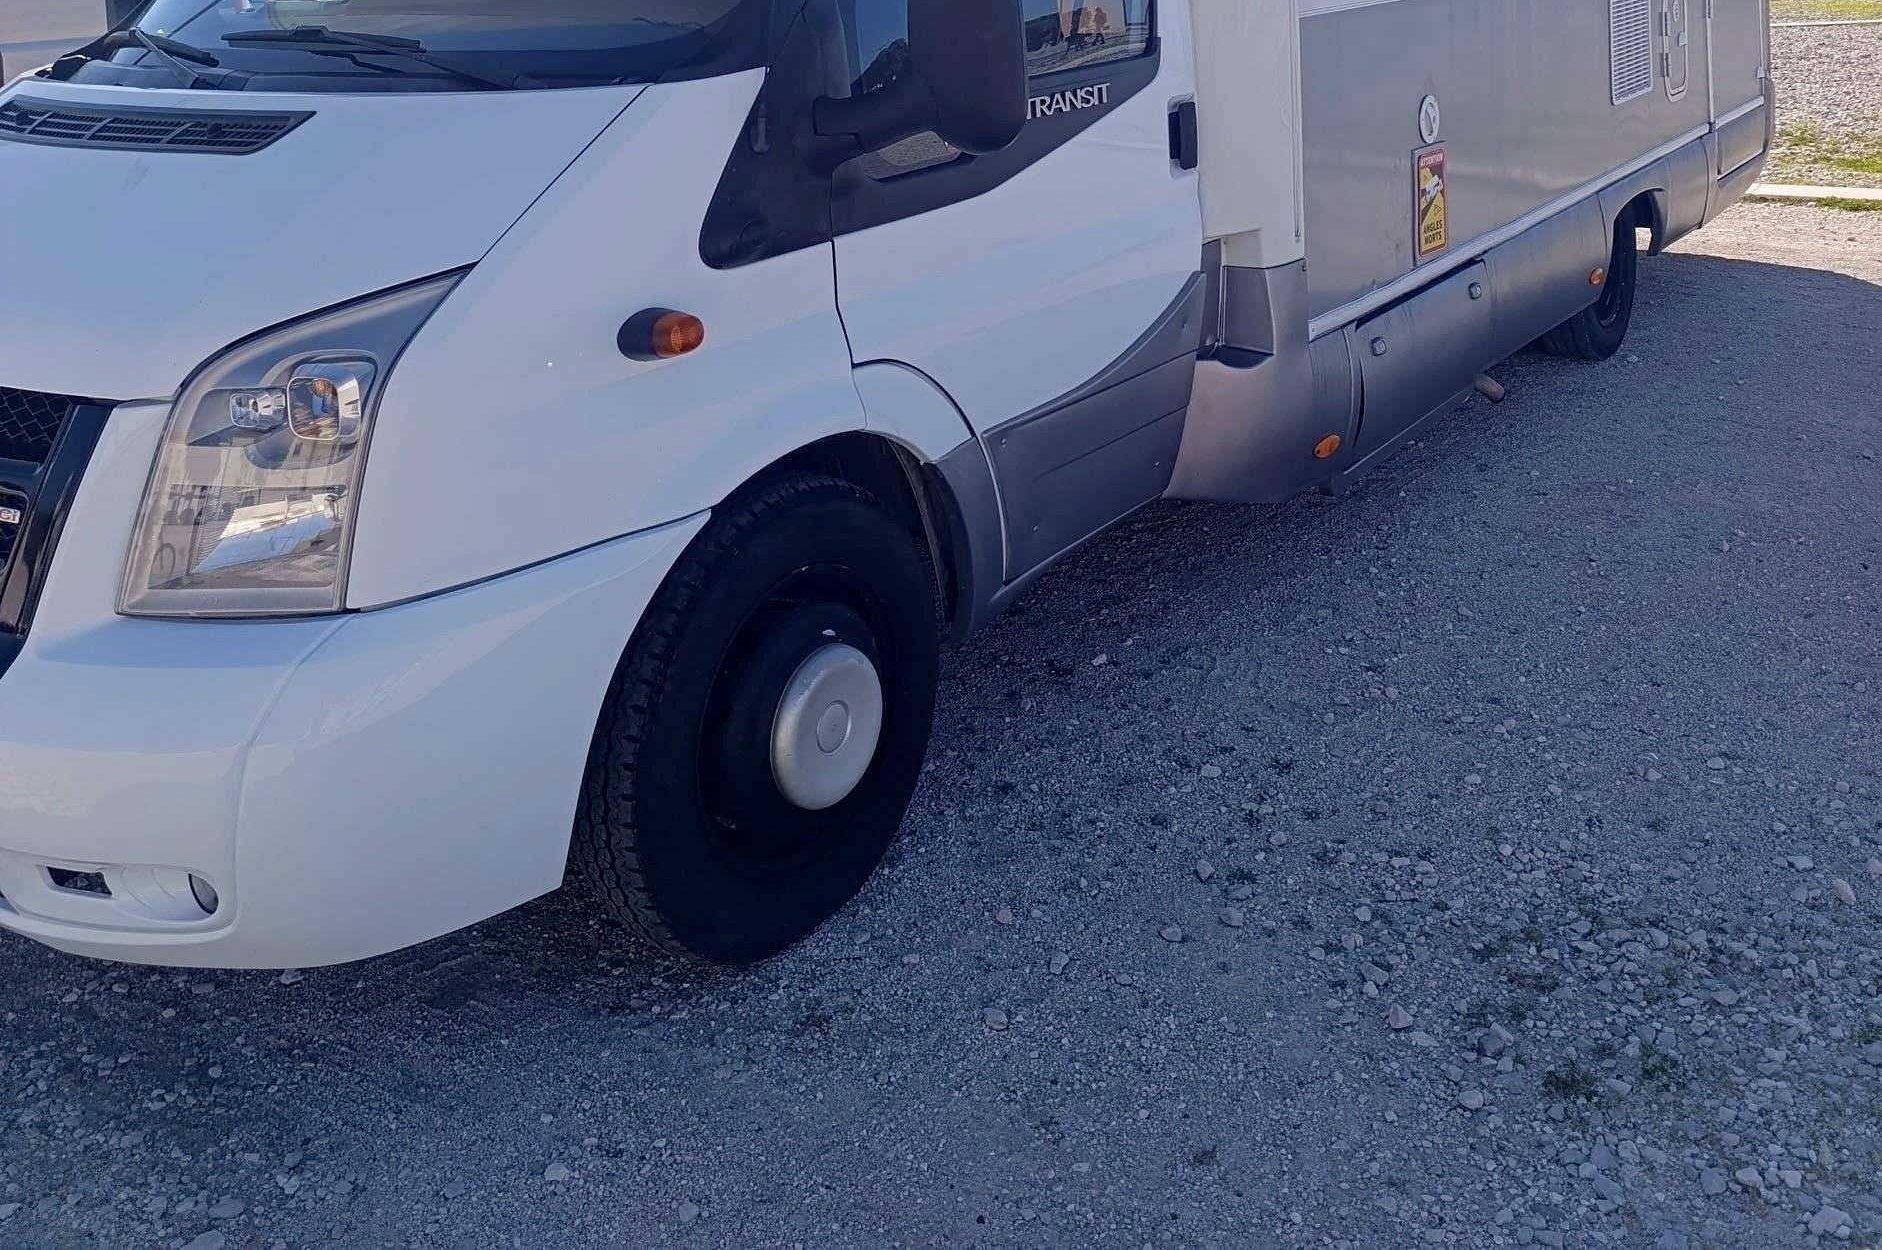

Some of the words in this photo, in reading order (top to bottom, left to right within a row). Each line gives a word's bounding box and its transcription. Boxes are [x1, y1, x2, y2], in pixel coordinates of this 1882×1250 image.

[1026, 82, 1111, 120] TRANSIT
[1424, 219, 1443, 235] ANGLES
[1424, 230, 1442, 246] MORTS
[0, 509, 18, 521] Ci
